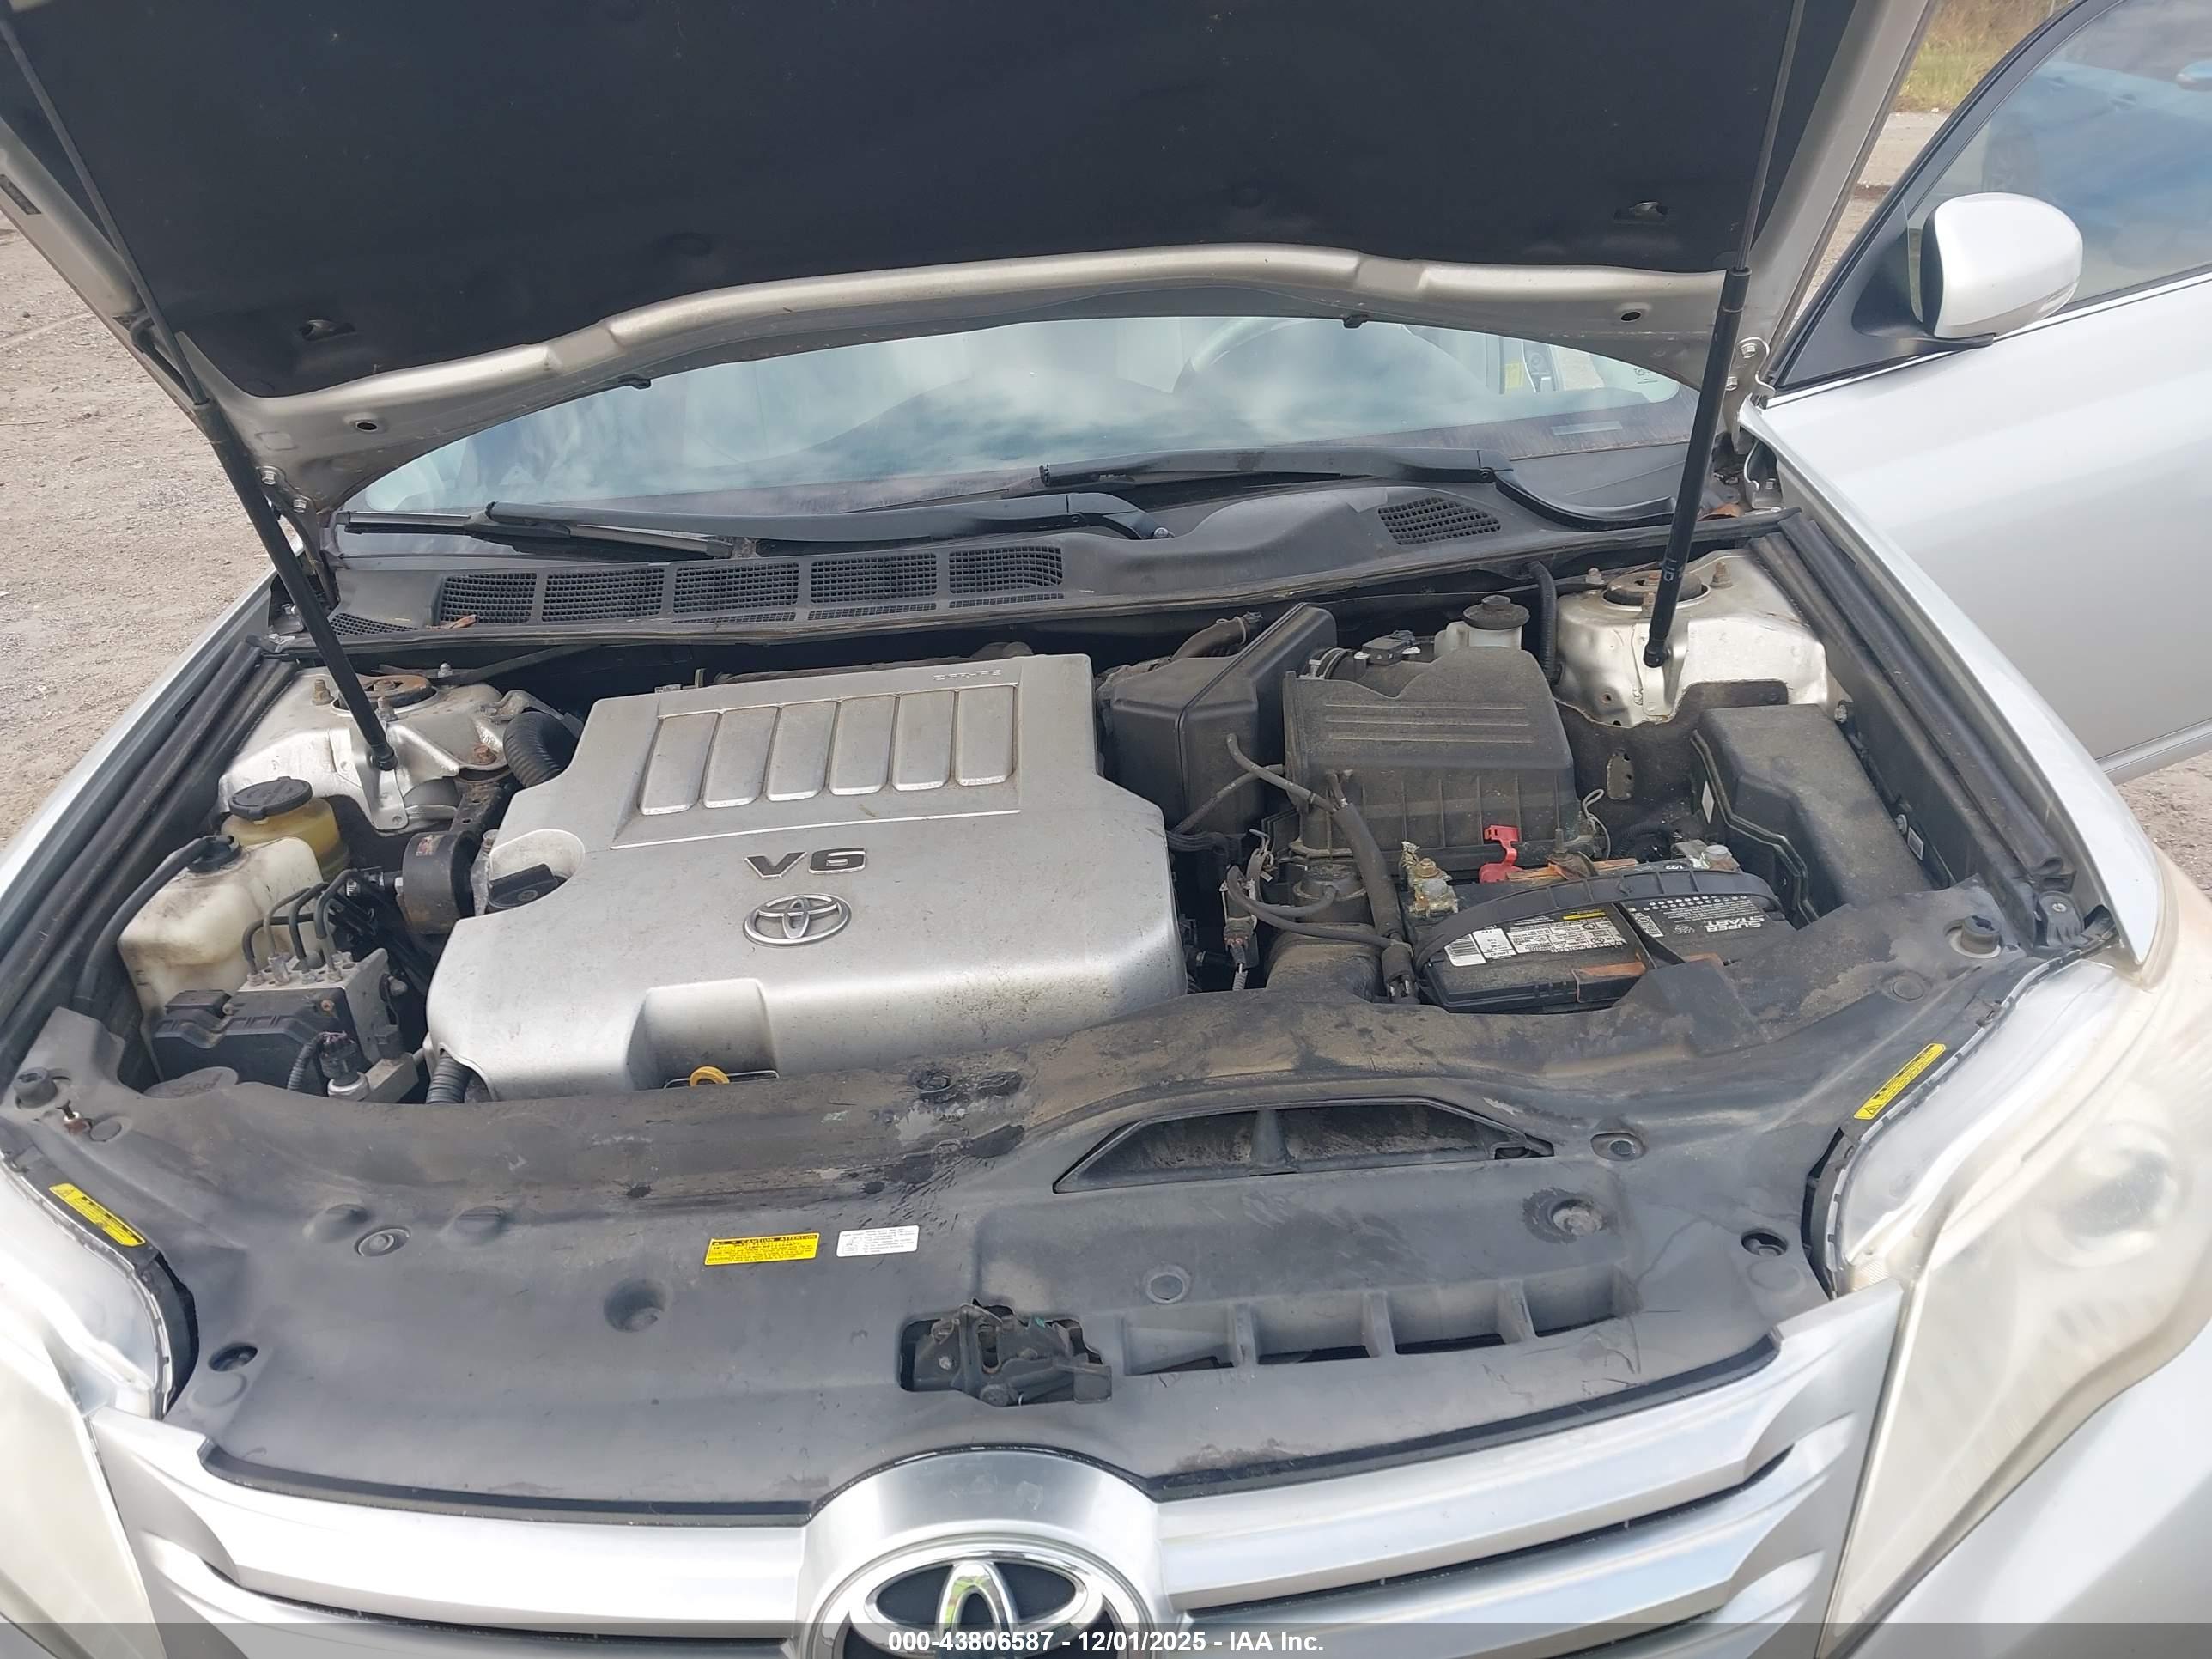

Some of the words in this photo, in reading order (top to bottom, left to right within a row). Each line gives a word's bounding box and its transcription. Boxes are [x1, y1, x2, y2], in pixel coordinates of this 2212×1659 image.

[744, 847, 866, 880] V6
[1705, 915, 1765, 927] START
[1704, 922, 1762, 933] SUPER
